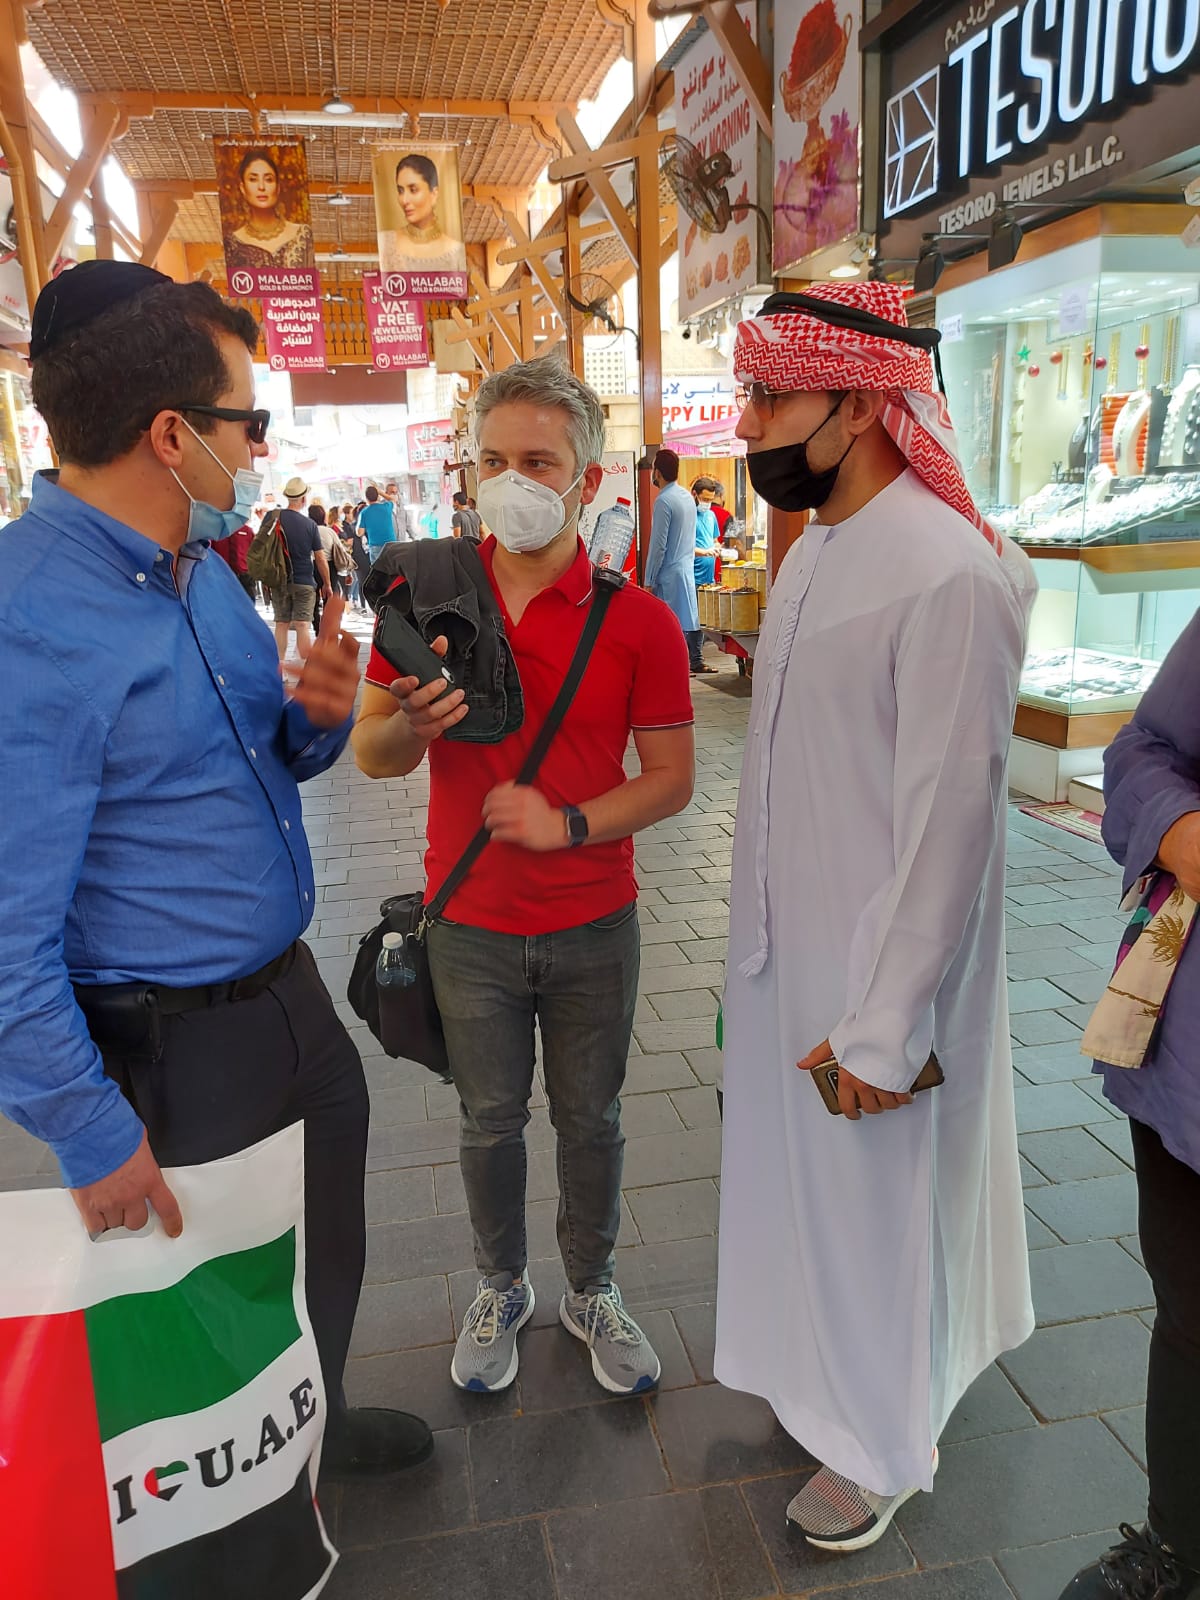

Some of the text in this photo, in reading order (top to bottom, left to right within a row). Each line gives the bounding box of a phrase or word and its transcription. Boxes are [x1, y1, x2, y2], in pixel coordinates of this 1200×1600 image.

[709, 98, 750, 156] MORNING
[938, 191, 996, 234] TESORO
[1068, 135, 1124, 182] L.L.C.
[257, 274, 313, 285] MALABAR
[411, 277, 463, 287] MALABAR
[381, 300, 409, 314] VAT
[267, 309, 320, 322] بدون الضريبة
[377, 312, 416, 326] FREE
[276, 322, 314, 333] المضافة
[372, 325, 423, 335] JEWELLERY
[287, 356, 324, 364] MALABAR
[392, 352, 427, 361] MALABAR
[684, 382, 734, 404] ابي
[661, 405, 694, 422] PPY
[112, 1377, 316, 1525] I U.A.E
